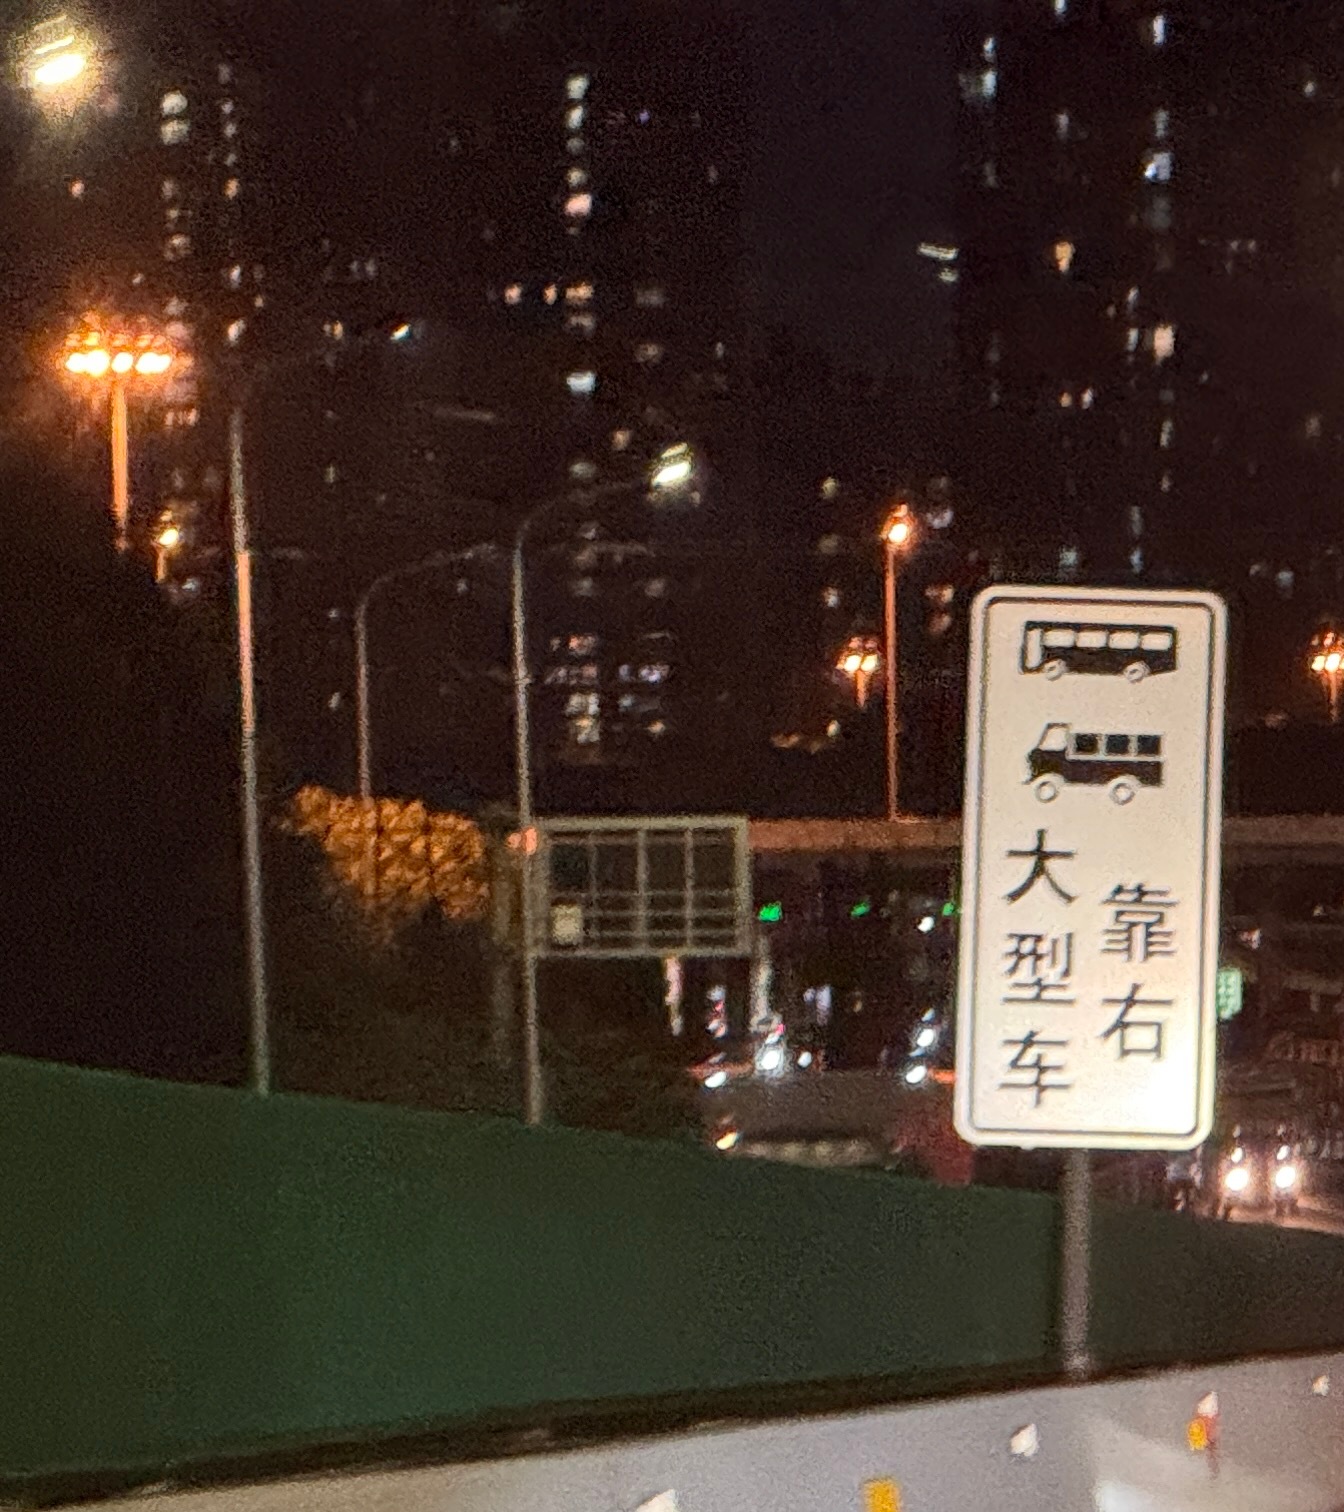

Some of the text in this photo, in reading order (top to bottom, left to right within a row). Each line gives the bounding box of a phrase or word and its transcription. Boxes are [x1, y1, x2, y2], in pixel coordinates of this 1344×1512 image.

[997, 826, 1080, 1109] 大型车
[1098, 881, 1180, 1064] 靠右
